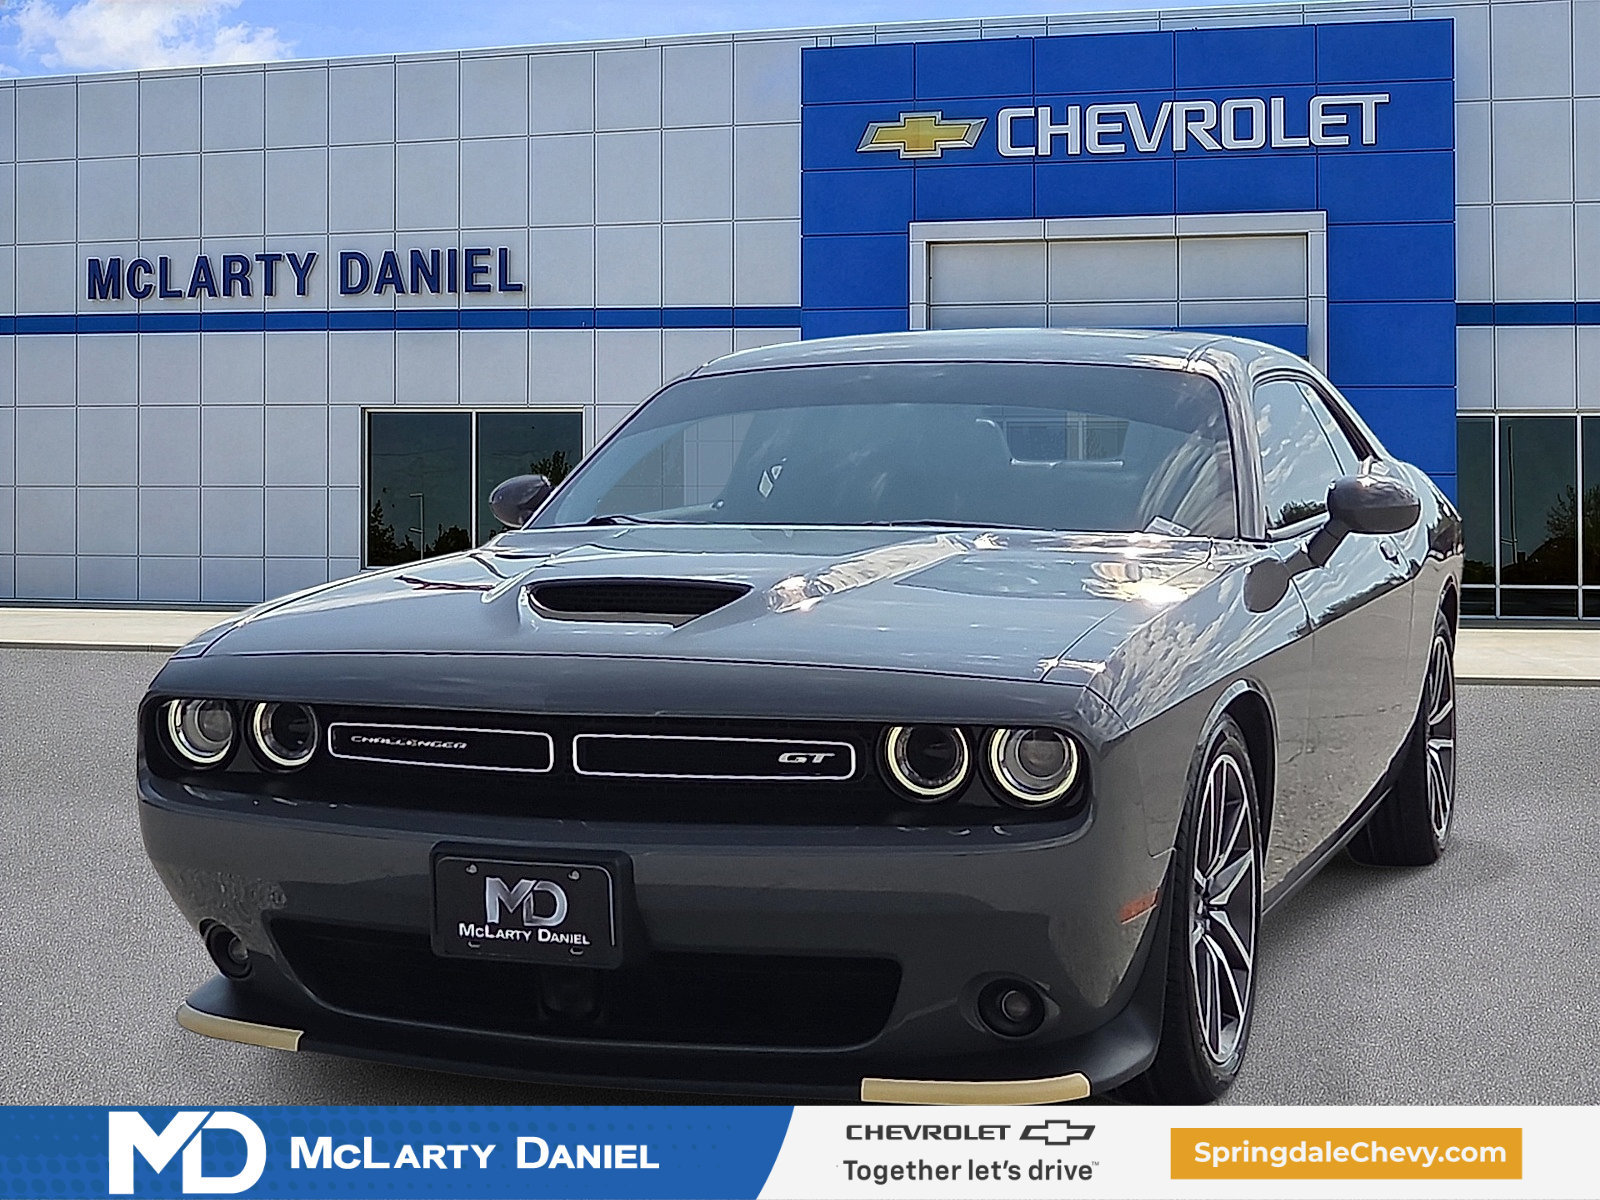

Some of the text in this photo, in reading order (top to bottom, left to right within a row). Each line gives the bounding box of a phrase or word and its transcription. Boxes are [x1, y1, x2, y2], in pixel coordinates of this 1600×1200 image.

[997, 93, 1390, 158] CHEVROLET
[338, 246, 525, 297] DANIEL
[777, 752, 835, 764] GT
[485, 877, 568, 926] MD
